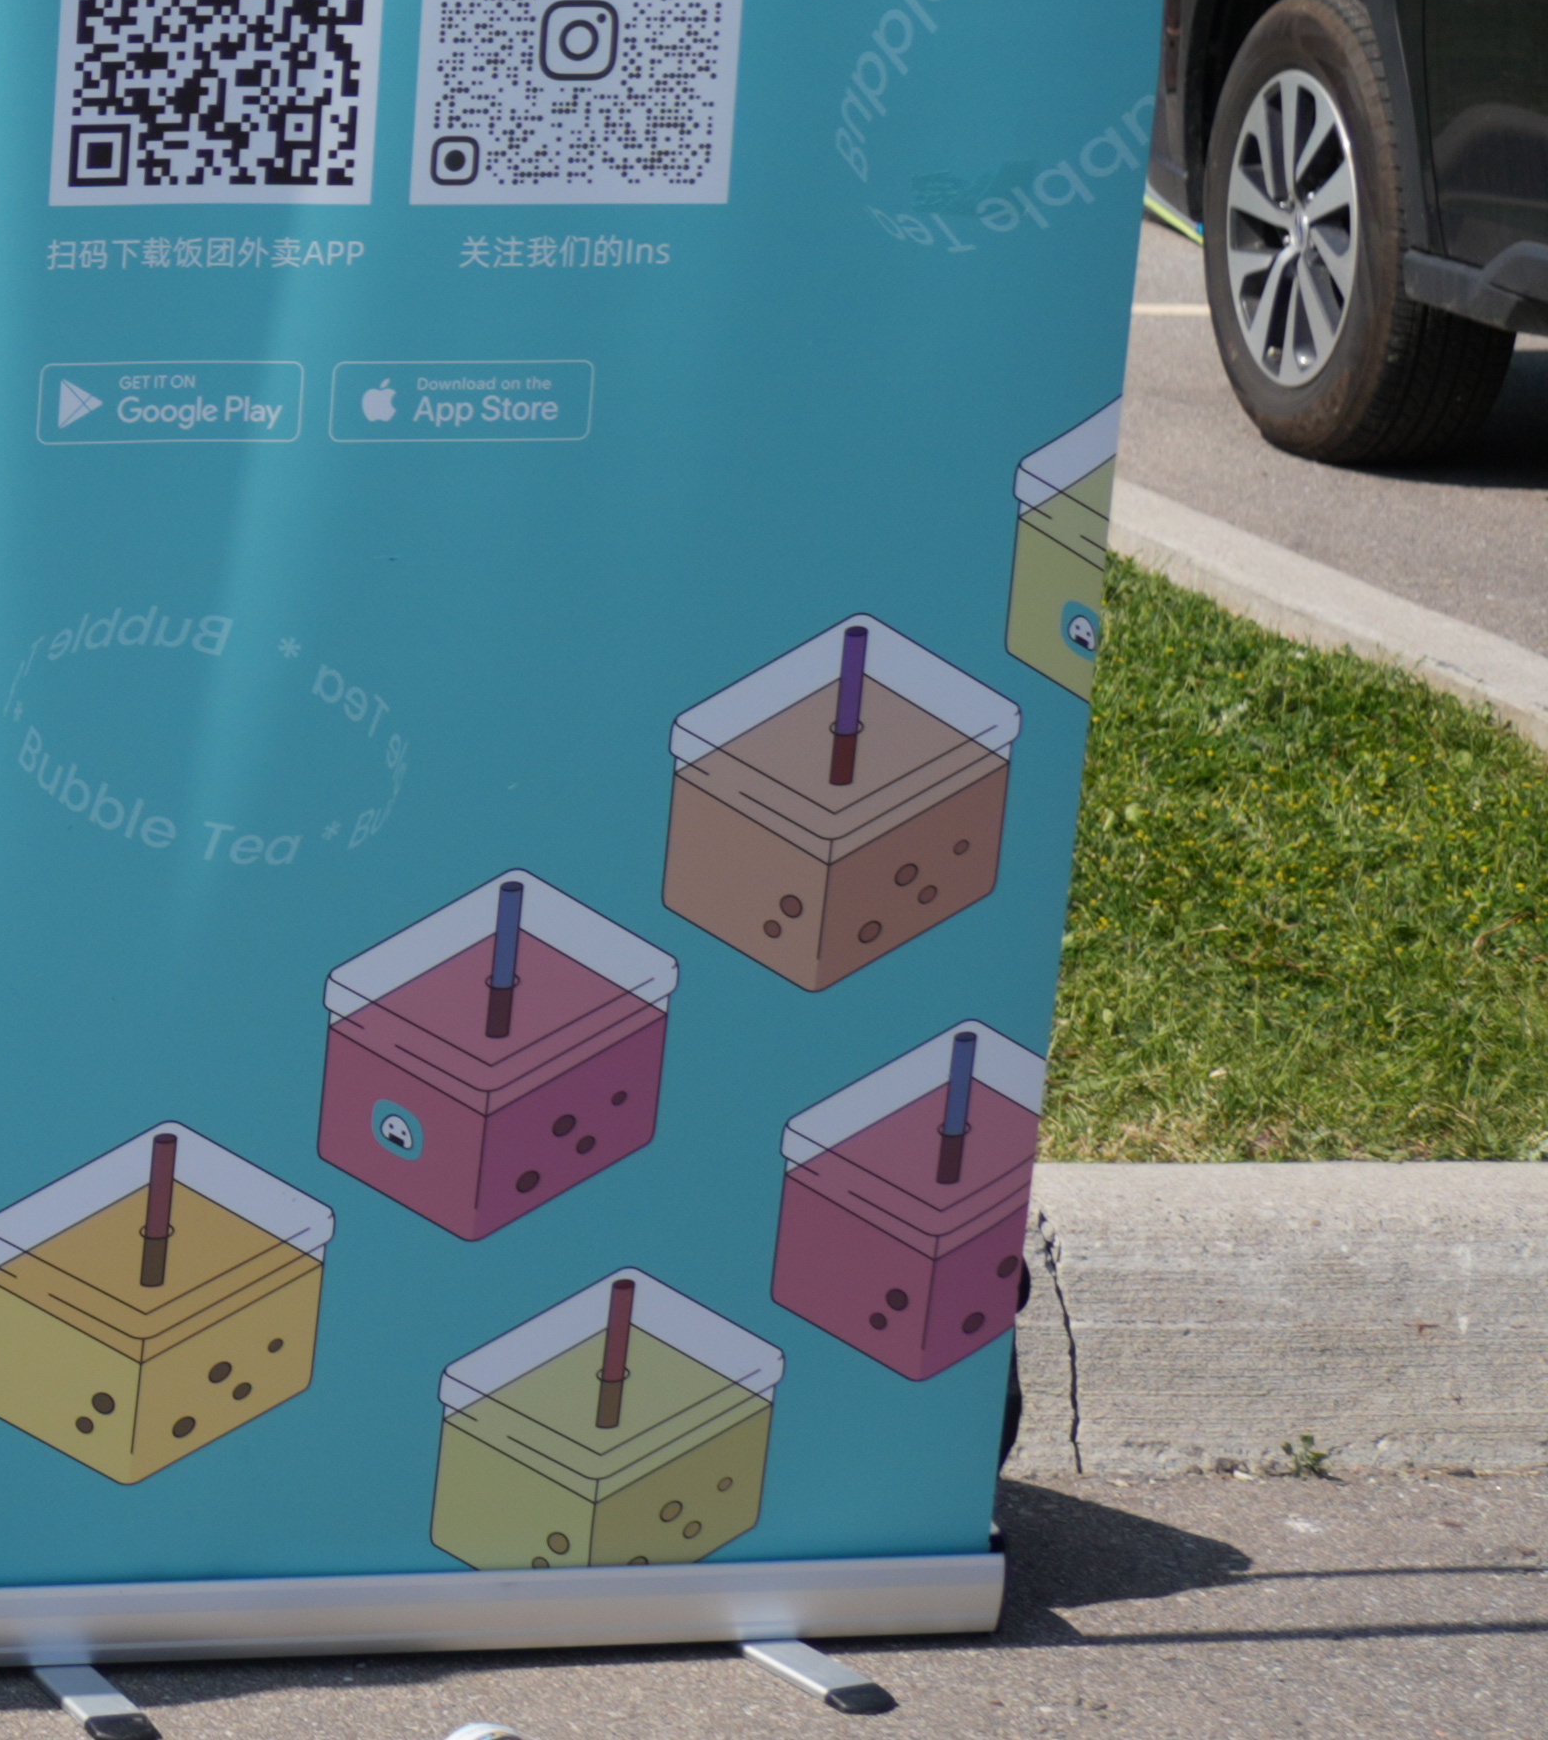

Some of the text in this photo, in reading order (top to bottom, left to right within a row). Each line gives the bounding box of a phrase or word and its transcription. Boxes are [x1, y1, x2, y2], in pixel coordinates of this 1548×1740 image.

[46, 236, 365, 272] 扫码下载饭团外卖APP
[459, 235, 671, 270] 关注我们的Ins
[119, 375, 196, 390] GET IT ON
[417, 376, 552, 391] Download on the
[116, 396, 284, 430] Google Play
[412, 394, 559, 426] App Store
[18, 724, 304, 866] Bubble Tea
